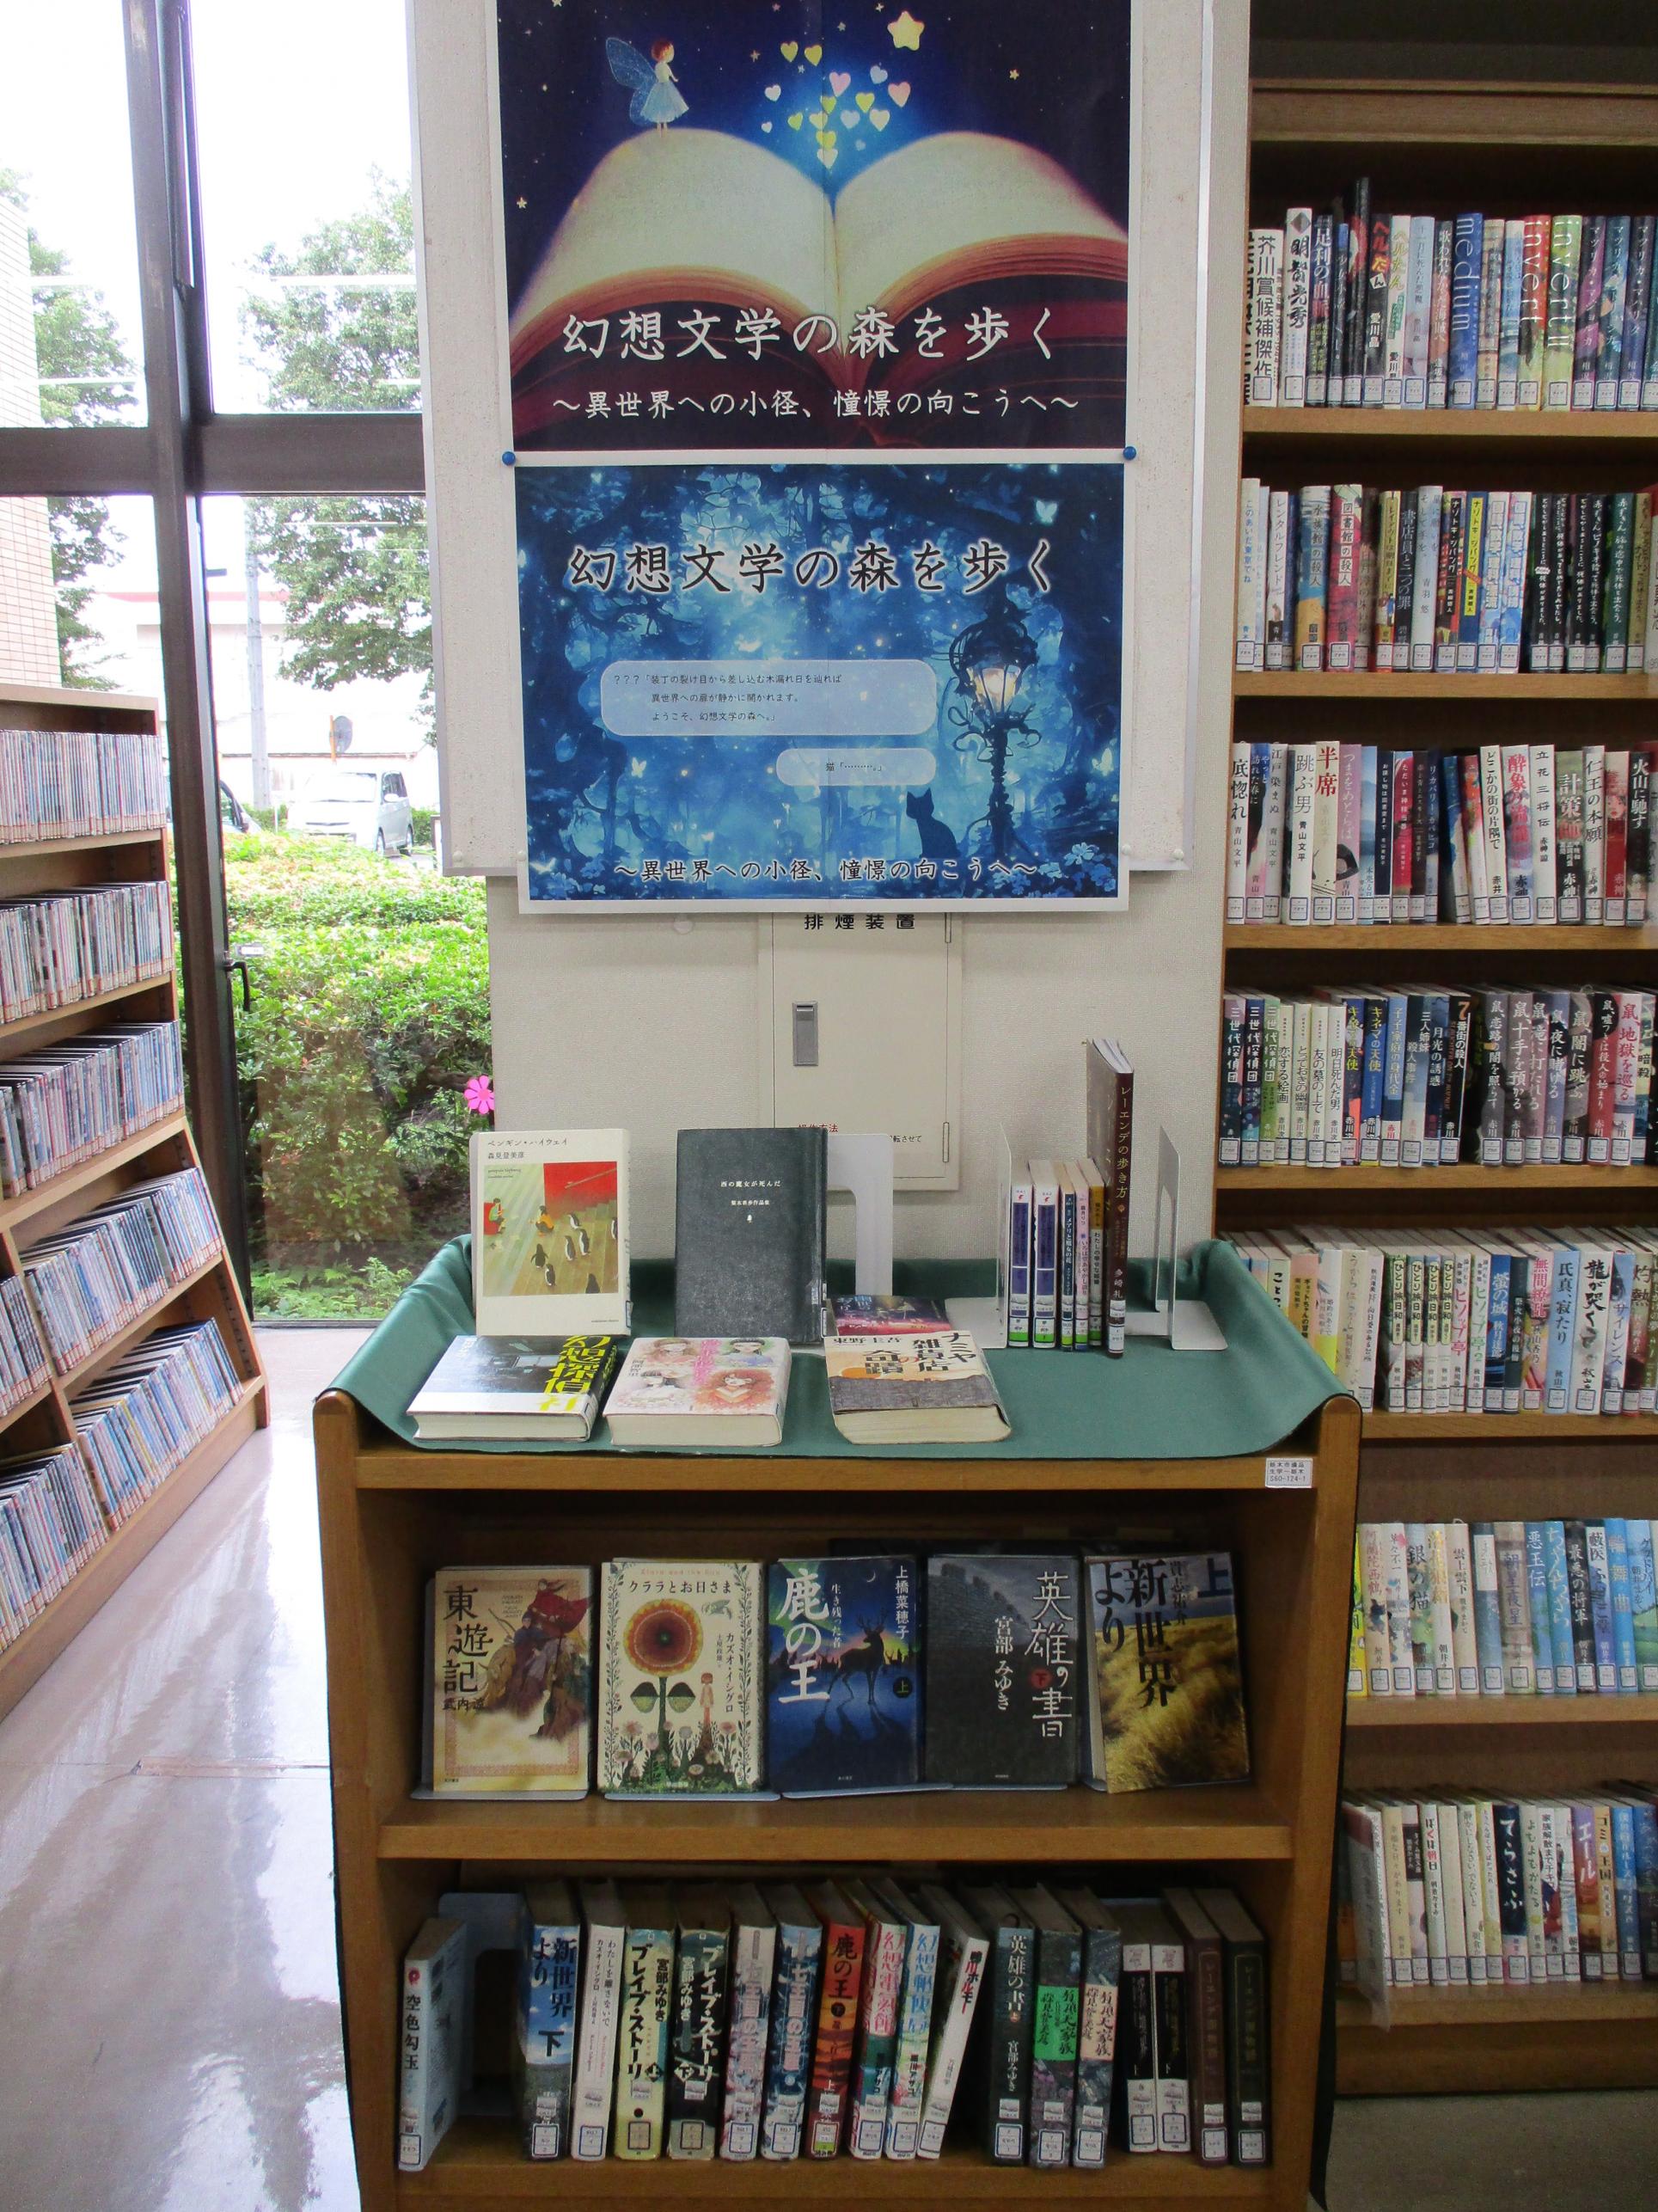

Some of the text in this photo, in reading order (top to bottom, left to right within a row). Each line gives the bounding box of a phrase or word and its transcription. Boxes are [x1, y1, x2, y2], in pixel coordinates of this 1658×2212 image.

[1287, 236, 1309, 329] 明智光秀
[1371, 221, 1392, 289] ヘルたん
[1452, 218, 1480, 332] medium
[1520, 220, 1549, 323] invert
[562, 306, 1054, 361] 幻想文学の森を歩く
[1254, 236, 1276, 377] 芥川賞候補傑作
[570, 540, 1052, 594] 幻想文学の森を歩く
[1273, 499, 1287, 586] レンタルフレンド
[1308, 504, 1324, 586] 水族館の殺人
[1338, 502, 1355, 586] 図書館の殺人
[1397, 511, 1416, 610] 書店員と二つの罪
[651, 692, 799, 703] 異世界への扉が静かに開かれます。
[652, 711, 777, 722] ようこそ、幻想文学の森へ。」
[1231, 758, 1249, 820] 底惚れ
[1294, 755, 1314, 815] 跳ぶ男
[1314, 745, 1338, 798] 半席
[1485, 751, 1502, 850] どこかの街の片隅で
[1535, 751, 1551, 828] 立花三将伝
[1585, 759, 1605, 843] 仁王の本願
[1630, 758, 1650, 830] 火山に馳す
[1557, 773, 1582, 840] 計策師
[1297, 820, 1307, 862] 青山文平
[804, 913, 915, 930] 排煙装置
[1227, 1008, 1241, 1083] 三世代探偵団
[1246, 1007, 1261, 1082] 三世代探偵団
[1263, 1007, 1278, 1082] 三世代探偵団
[1367, 1006, 1383, 1072] キネマの天使
[1429, 1026, 1444, 1087] 月光の誘惑
[1453, 1001, 1471, 1069] 7番街の殺人
[1487, 999, 1505, 1109] 鼠、恋路の闇を照らす
[1511, 1001, 1533, 1111] 鼠、十手を預かる
[1549, 1008, 1569, 1100] 鼠、夜に賭ける
[1568, 1010, 1592, 1100] 鼠、闇に跳ぶ
[1615, 1002, 1641, 1102] 鼠、地獄を巡る
[1277, 1046, 1290, 1104] 恋する絵画
[1294, 1045, 1307, 1112] とっておきの幽霊
[1312, 1048, 1325, 1114] 友の墓の上で
[1331, 1047, 1343, 1111] 明日死んだ男
[487, 1137, 568, 1147] ペンギン・ハイウェイ
[1115, 1085, 1132, 1200] レーエンデの歩き方
[720, 1180, 781, 1188] 西の魔女が死んだ
[1393, 1263, 1404, 1320] ひとり旅日和
[1411, 1263, 1423, 1320] ひとり旅日和
[1427, 1264, 1439, 1320] ひとり旅日和
[1442, 1263, 1453, 1320] ひとり旅日和
[1557, 1262, 1575, 1345] 氏真、寂たり
[1583, 1259, 1610, 1327] 龍が哭く
[1633, 1264, 1651, 1308] 灼熱
[941, 1332, 977, 1363] ナミヤ
[1610, 1299, 1629, 1366] サイレンス
[629, 1580, 731, 1595] クララとお日さま
[1197, 1557, 1234, 1598] 上
[1406, 1544, 1429, 1611] 銀の猫
[1502, 1553, 1523, 1626] 朝星夜星
[1526, 1529, 1546, 1589] 悪玉伝
[1568, 1543, 1589, 1627] 最悪の将軍
[775, 1567, 831, 1705] 鹿の王
[831, 1583, 843, 1650] 生き残った者
[895, 1565, 910, 1640] 上橋菜穂子
[1094, 1560, 1126, 1653] より
[1123, 1558, 1178, 1709] 新世界
[443, 1585, 494, 1694] 東遊記
[725, 1633, 735, 1713] カズオ・イシグロ
[993, 1614, 1015, 1712] 宮部みゆき
[1025, 1570, 1074, 1739] 英雄の書
[1425, 1817, 1439, 1872] ぼくは朝日
[1498, 1817, 1523, 1910] てらさふ
[1578, 1822, 1597, 1884] エール
[532, 1939, 550, 1988] より
[550, 1937, 578, 2019] 新世界
[654, 1958, 670, 2022] 宮部みゆき
[678, 1956, 694, 2022] 宮部みゆき
[828, 1933, 859, 2000] 鹿の王
[960, 1950, 983, 2016] 鴨川ホルモー
[1007, 1934, 1027, 2013] 英雄の書
[404, 1994, 421, 2072] 空色勾玉
[537, 2030, 565, 2058] 下
[1006, 2038, 1020, 2093] 宮部みゆき
